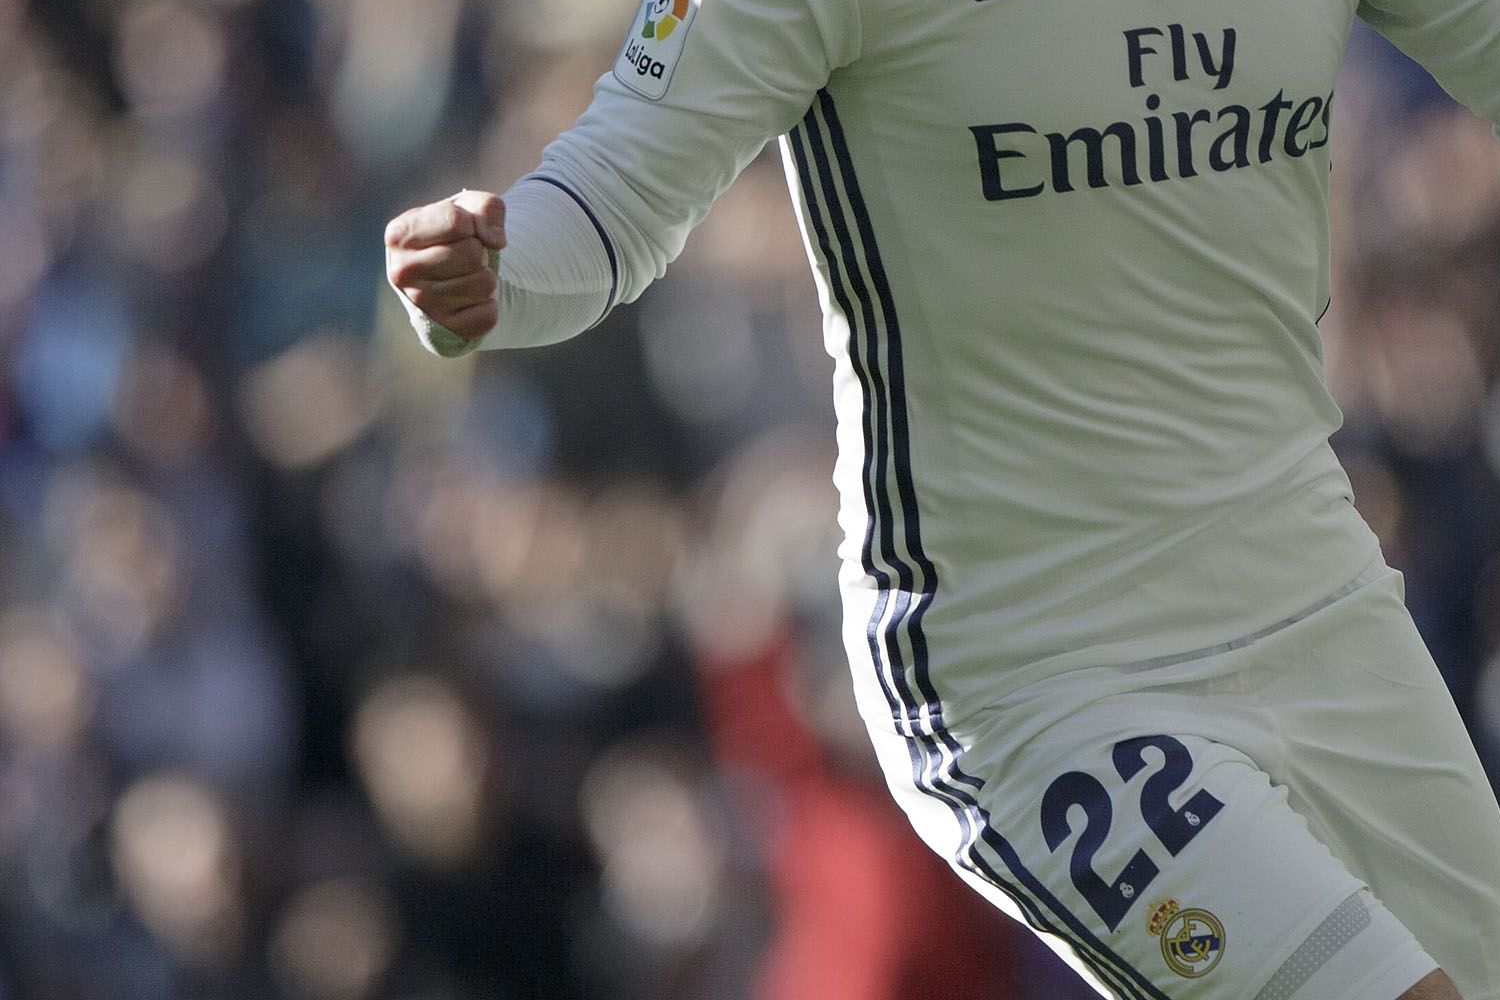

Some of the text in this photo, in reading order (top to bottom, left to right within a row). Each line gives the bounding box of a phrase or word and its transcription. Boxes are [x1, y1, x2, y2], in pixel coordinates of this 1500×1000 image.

[1122, 23, 1236, 90] Fly
[968, 87, 1334, 202] Emirates
[1040, 734, 1226, 934] 22
